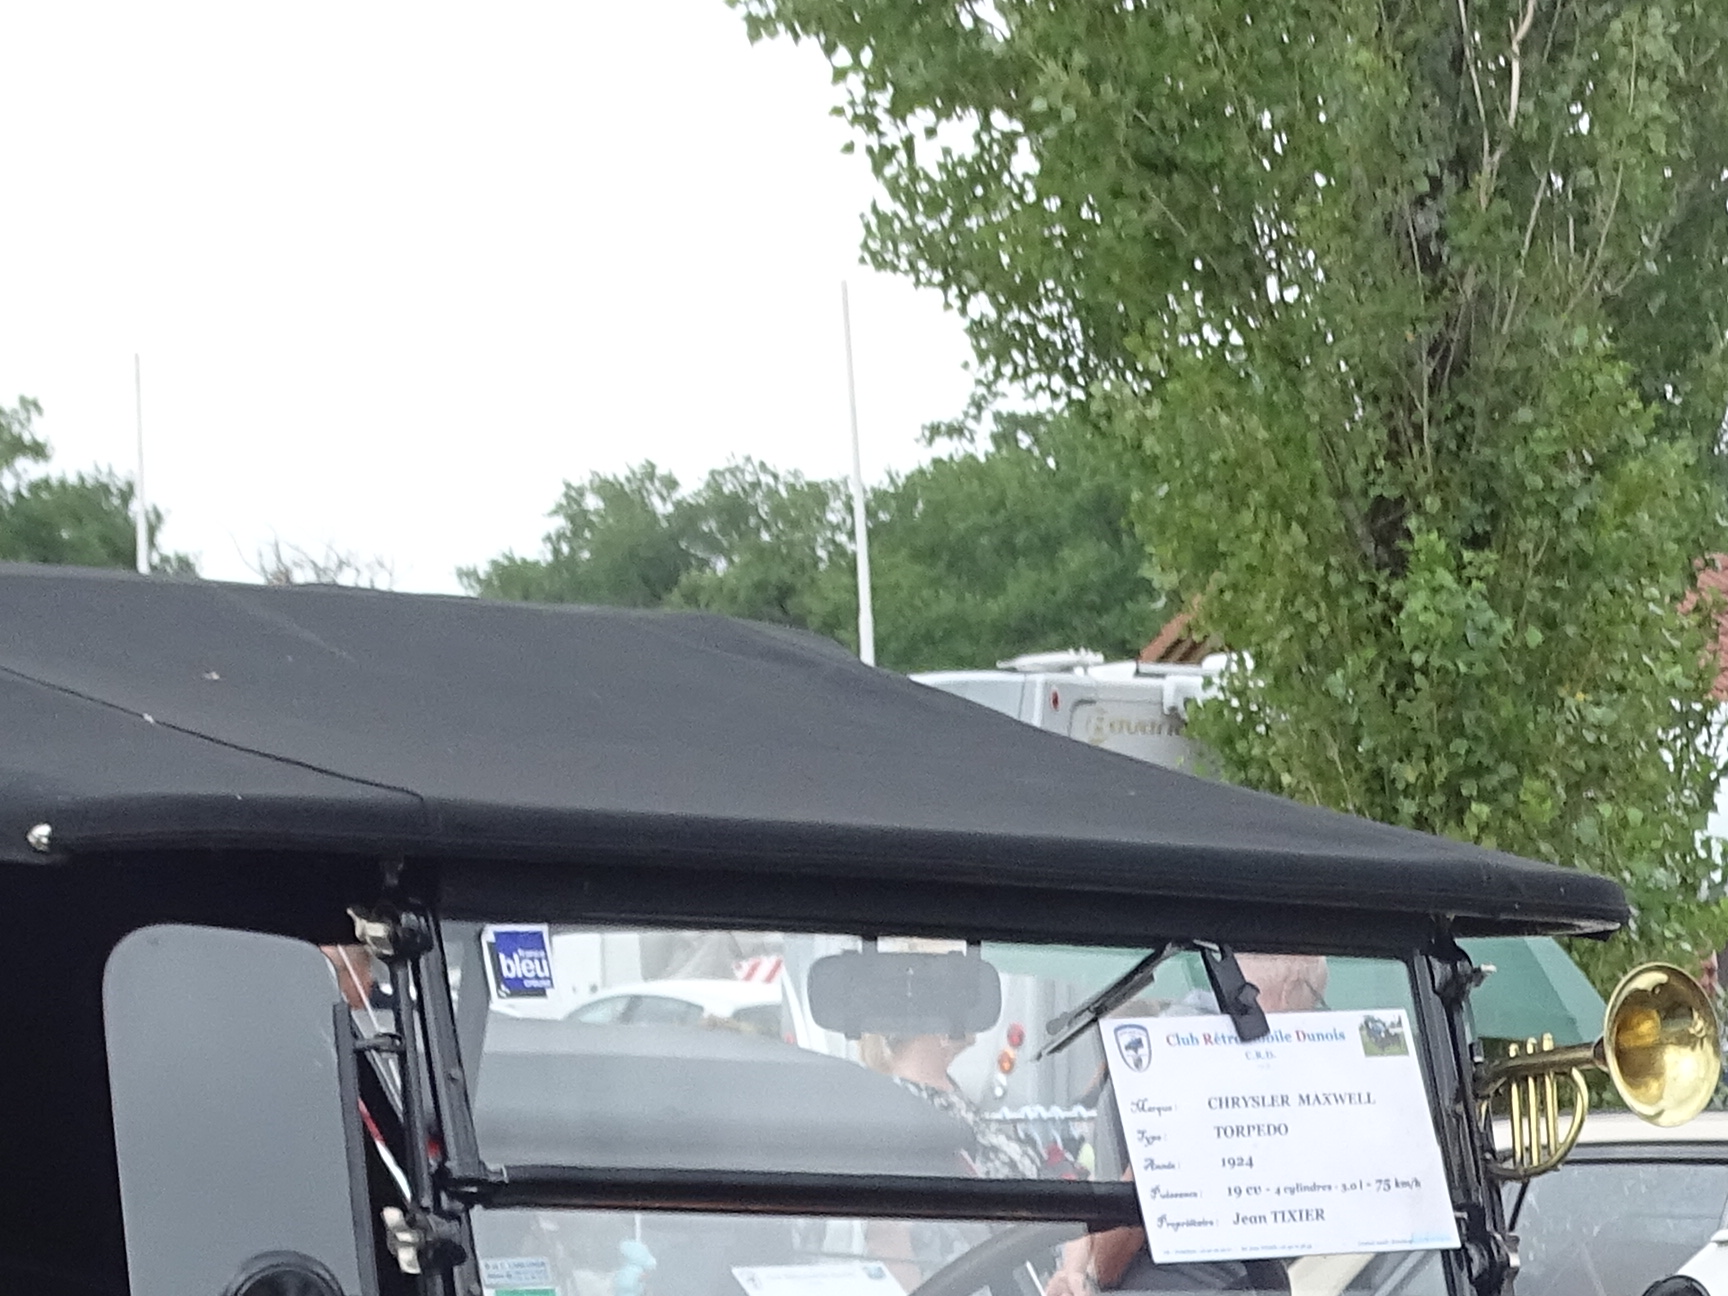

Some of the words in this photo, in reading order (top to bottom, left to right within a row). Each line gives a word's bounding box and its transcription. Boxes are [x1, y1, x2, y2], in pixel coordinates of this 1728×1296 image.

[498, 952, 551, 979] bleu
[1166, 1029, 1200, 1046] Club
[1295, 1027, 1346, 1043] Dunois
[1207, 1094, 1291, 1110] CHRYSLER
[1298, 1091, 1376, 1106] MAXWELL
[1214, 1123, 1289, 1139] TORPEDO
[1221, 1155, 1254, 1169] 1924
[1227, 1185, 1243, 1199] 19
[1283, 1181, 1332, 1196] cylindres
[1375, 1178, 1392, 1192] 75
[1394, 1177, 1422, 1190] km/h
[1232, 1212, 1268, 1226] Jean
[1271, 1208, 1326, 1223] TIXIER
